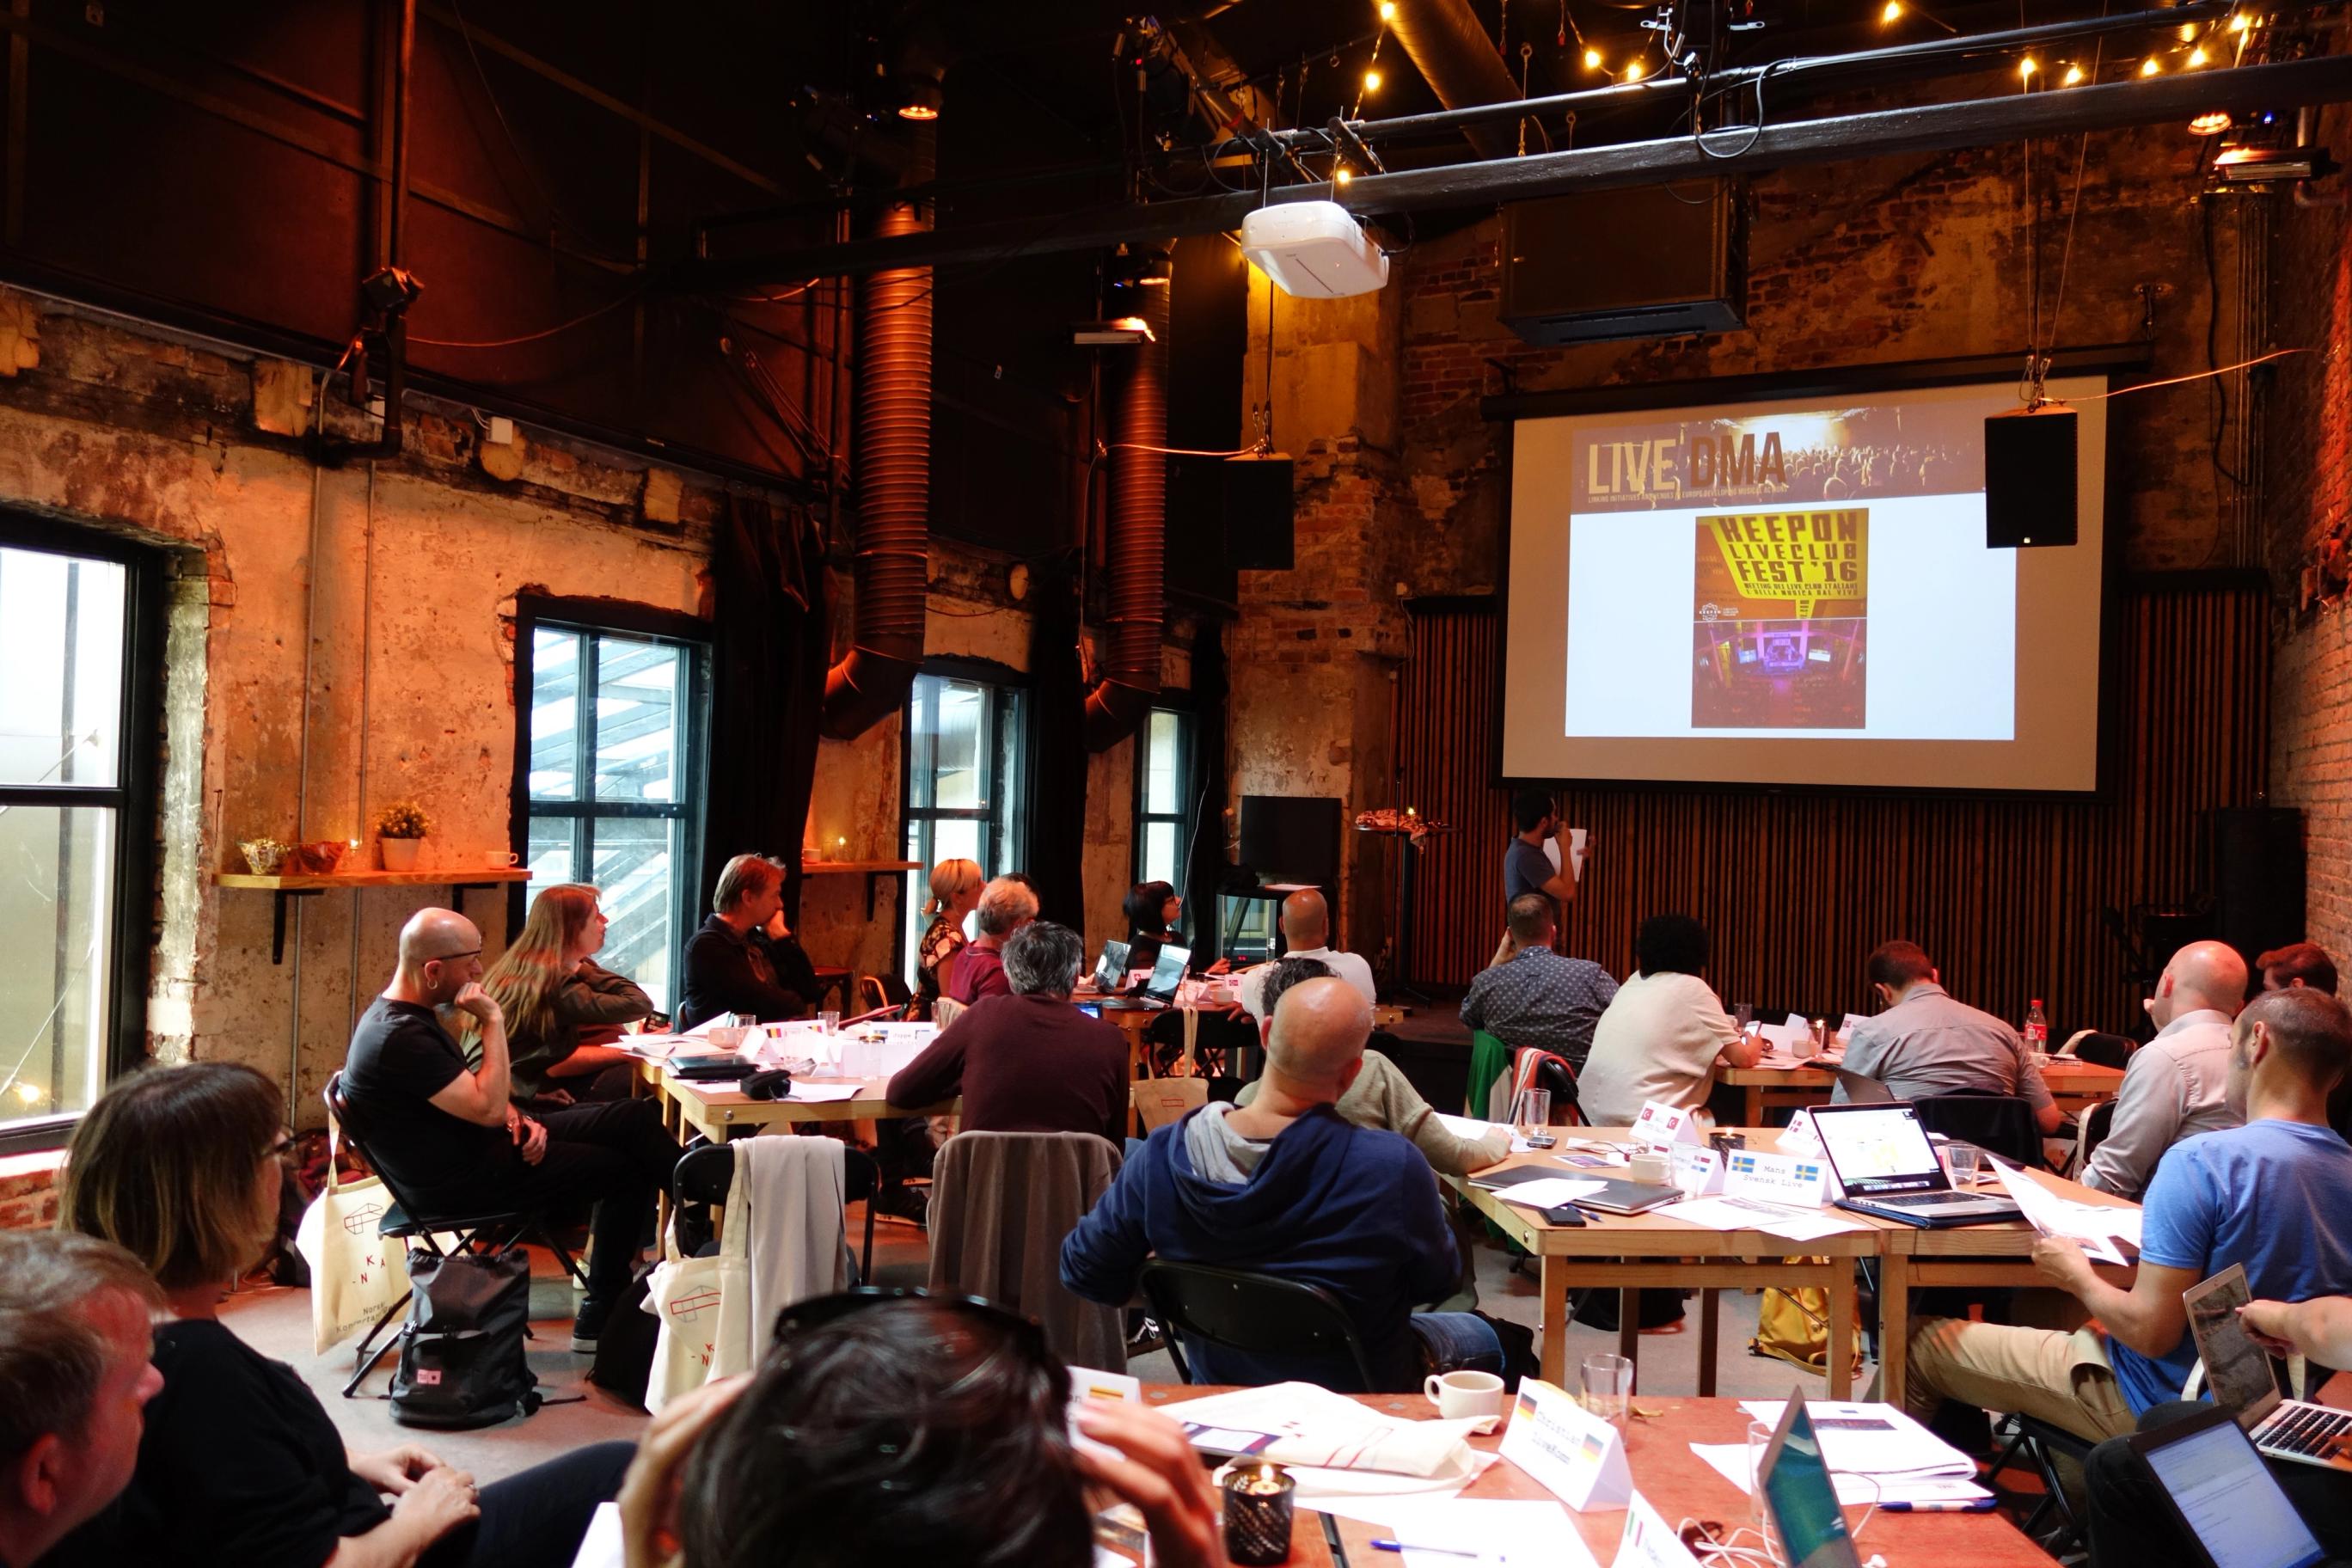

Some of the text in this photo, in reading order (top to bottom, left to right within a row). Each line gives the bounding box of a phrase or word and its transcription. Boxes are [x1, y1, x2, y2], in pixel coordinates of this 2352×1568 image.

[1589, 432, 1787, 494] LIVE DMA
[1718, 511, 1858, 542] KEEPON
[1736, 560, 1804, 583] FEST
[1824, 582, 1858, 591] ITALIANI
[1743, 1174, 1804, 1188] Svensk Live
[1536, 1410, 1581, 1447] Christian
